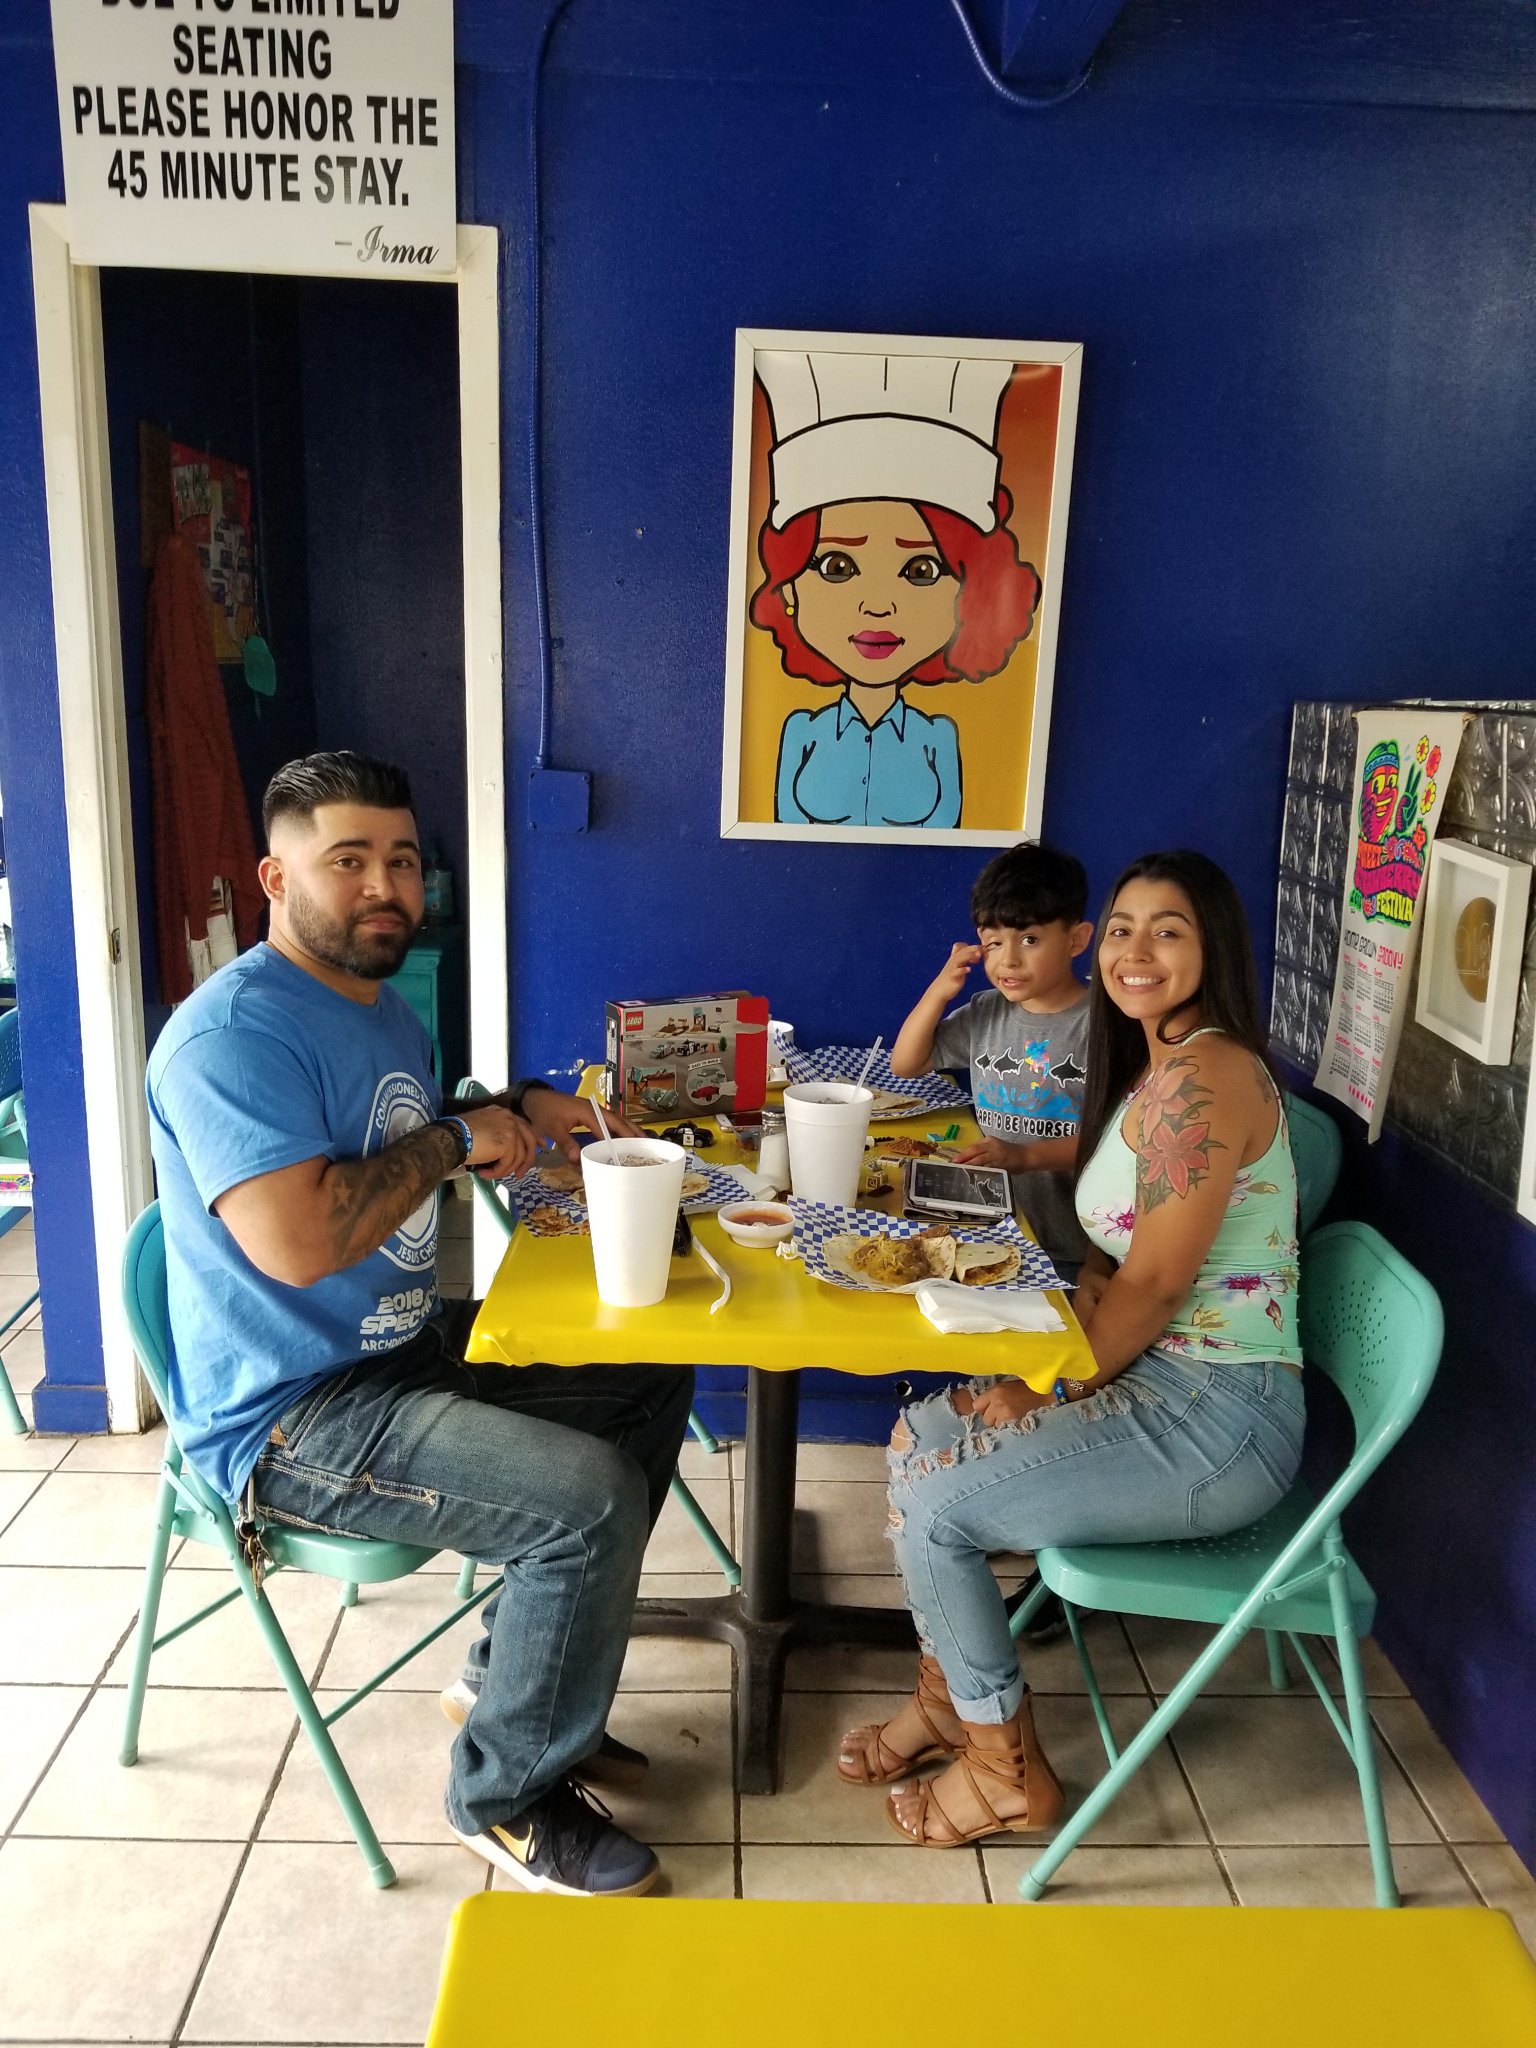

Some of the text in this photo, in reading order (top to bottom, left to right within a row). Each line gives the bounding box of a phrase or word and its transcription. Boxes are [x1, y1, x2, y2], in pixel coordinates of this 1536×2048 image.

[173, 24, 333, 79] SEATING
[73, 85, 439, 146] PLEASE HONOR THE
[107, 149, 409, 207] 45 MINUTE STAY.
[356, 224, 440, 265] Irma
[1376, 890, 1415, 921] FESTIVA
[627, 1016, 642, 1026] LEGO
[375, 1081, 421, 1130] COMMISSIONED
[1004, 1114, 1020, 1134] BE
[1022, 1117, 1078, 1139] YOURSEL
[396, 1243, 420, 1264] JESUS
[376, 1287, 424, 1315] 2018
